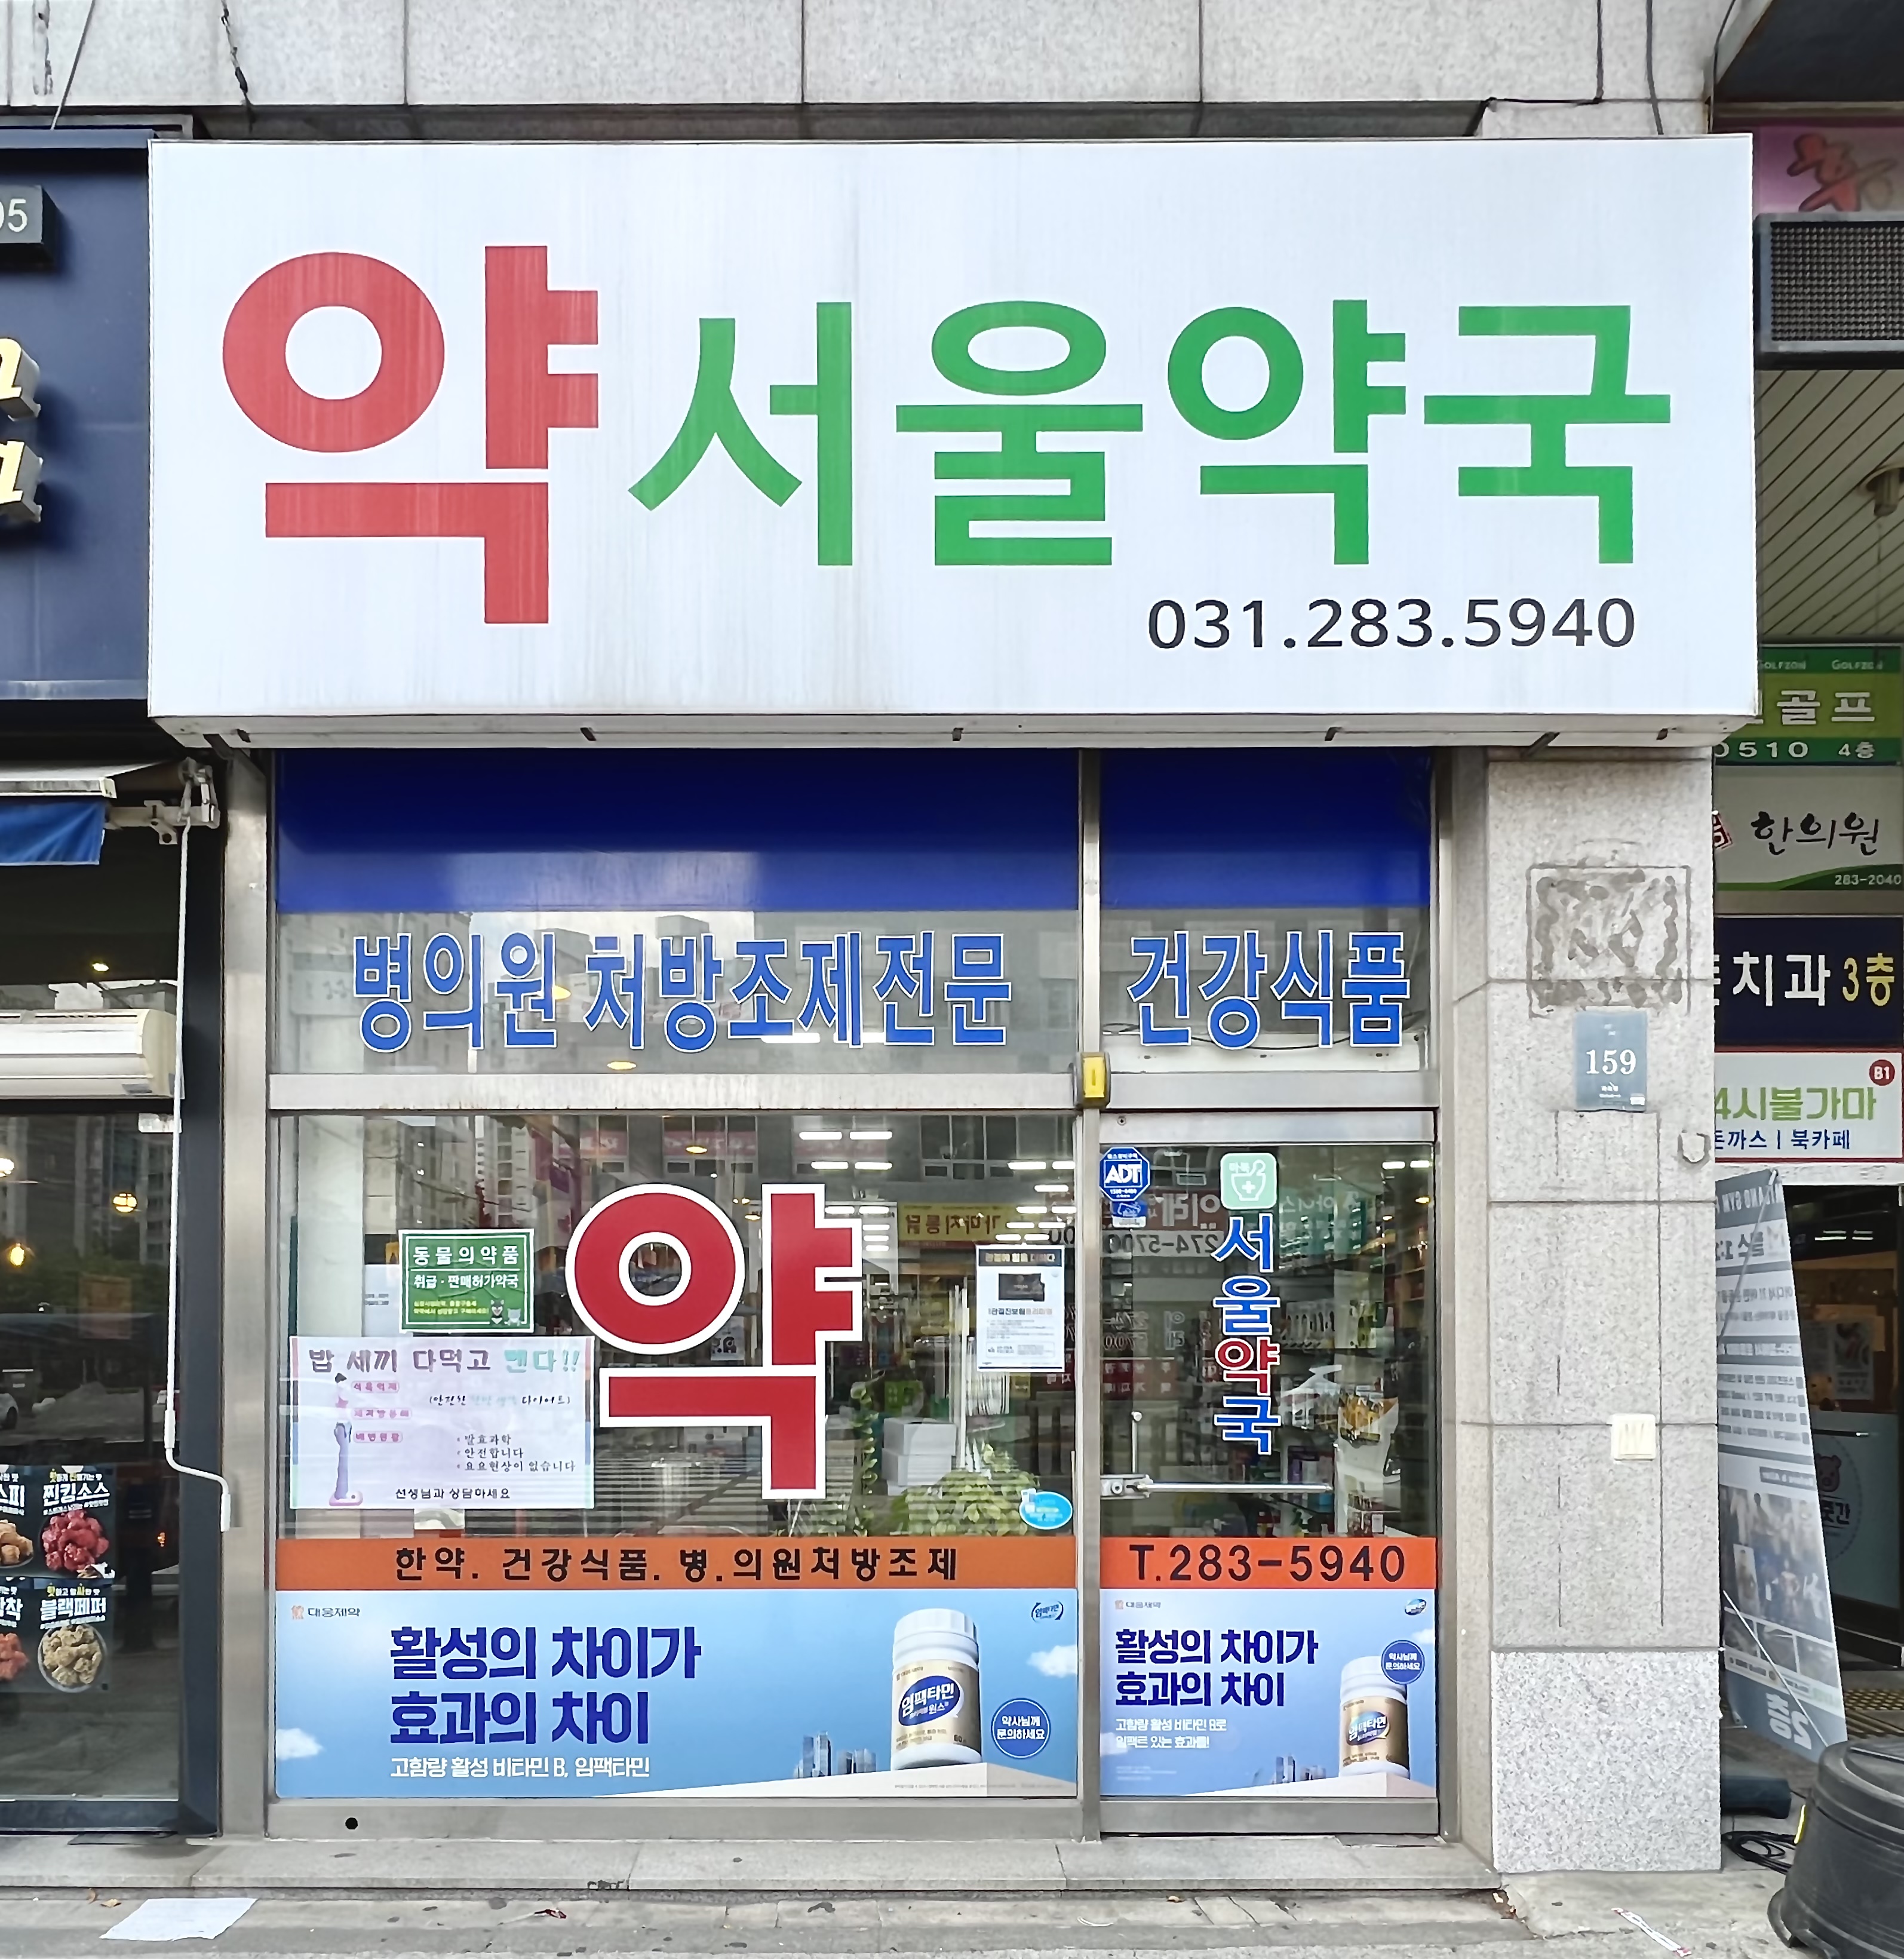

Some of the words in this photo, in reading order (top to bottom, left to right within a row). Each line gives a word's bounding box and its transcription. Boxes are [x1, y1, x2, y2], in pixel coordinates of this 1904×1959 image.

[223, 245, 598, 624] 약
[628, 299, 1670, 566] 서울약국
[1147, 598, 1635, 648] 031.283.5940
[1751, 811, 1879, 856] 한의원
[1834, 874, 1902, 886] 283-2040
[354, 932, 557, 1052] 병의원
[583, 931, 1011, 1052] 처방조제전문
[1127, 930, 1410, 1050] 건강식품
[1842, 953, 1894, 1006] 3층
[1586, 1049, 1636, 1074] 159
[1874, 1066, 1890, 1080] B1
[1791, 1129, 1850, 1150] 북카페
[1104, 1163, 1142, 1184] ADT
[413, 1274, 437, 1289] 취급
[565, 1183, 863, 1500] 약
[1211, 1213, 1281, 1456] 서울약국
[309, 1349, 334, 1372] 밥
[347, 1349, 398, 1372] 세끼
[413, 1349, 491, 1372] 다먹고
[42, 1482, 110, 1507] 찐킹소스
[396, 1547, 478, 1581] 한약.
[502, 1548, 660, 1582] 건강식품.
[1129, 1544, 1405, 1582] T.283-5940
[308, 1608, 361, 1617] 대웅제약
[390, 1626, 536, 1679] 활성의
[551, 1626, 702, 1679] 차이가
[1116, 1629, 1211, 1665] 활성의
[1221, 1629, 1319, 1665] 차이가
[1116, 1671, 1211, 1706] 효과의
[1221, 1672, 1284, 1706] 차이
[390, 1691, 536, 1745] 효과의
[551, 1691, 649, 1745] 차이
[997, 1728, 1045, 1740] 문의하세요
[1002, 1715, 1040, 1727] 약사님께
[391, 1757, 447, 1778] 고함량
[451, 1757, 489, 1778] 활성
[493, 1757, 549, 1778] 비타민
[575, 1757, 650, 1778] 임팩타민
